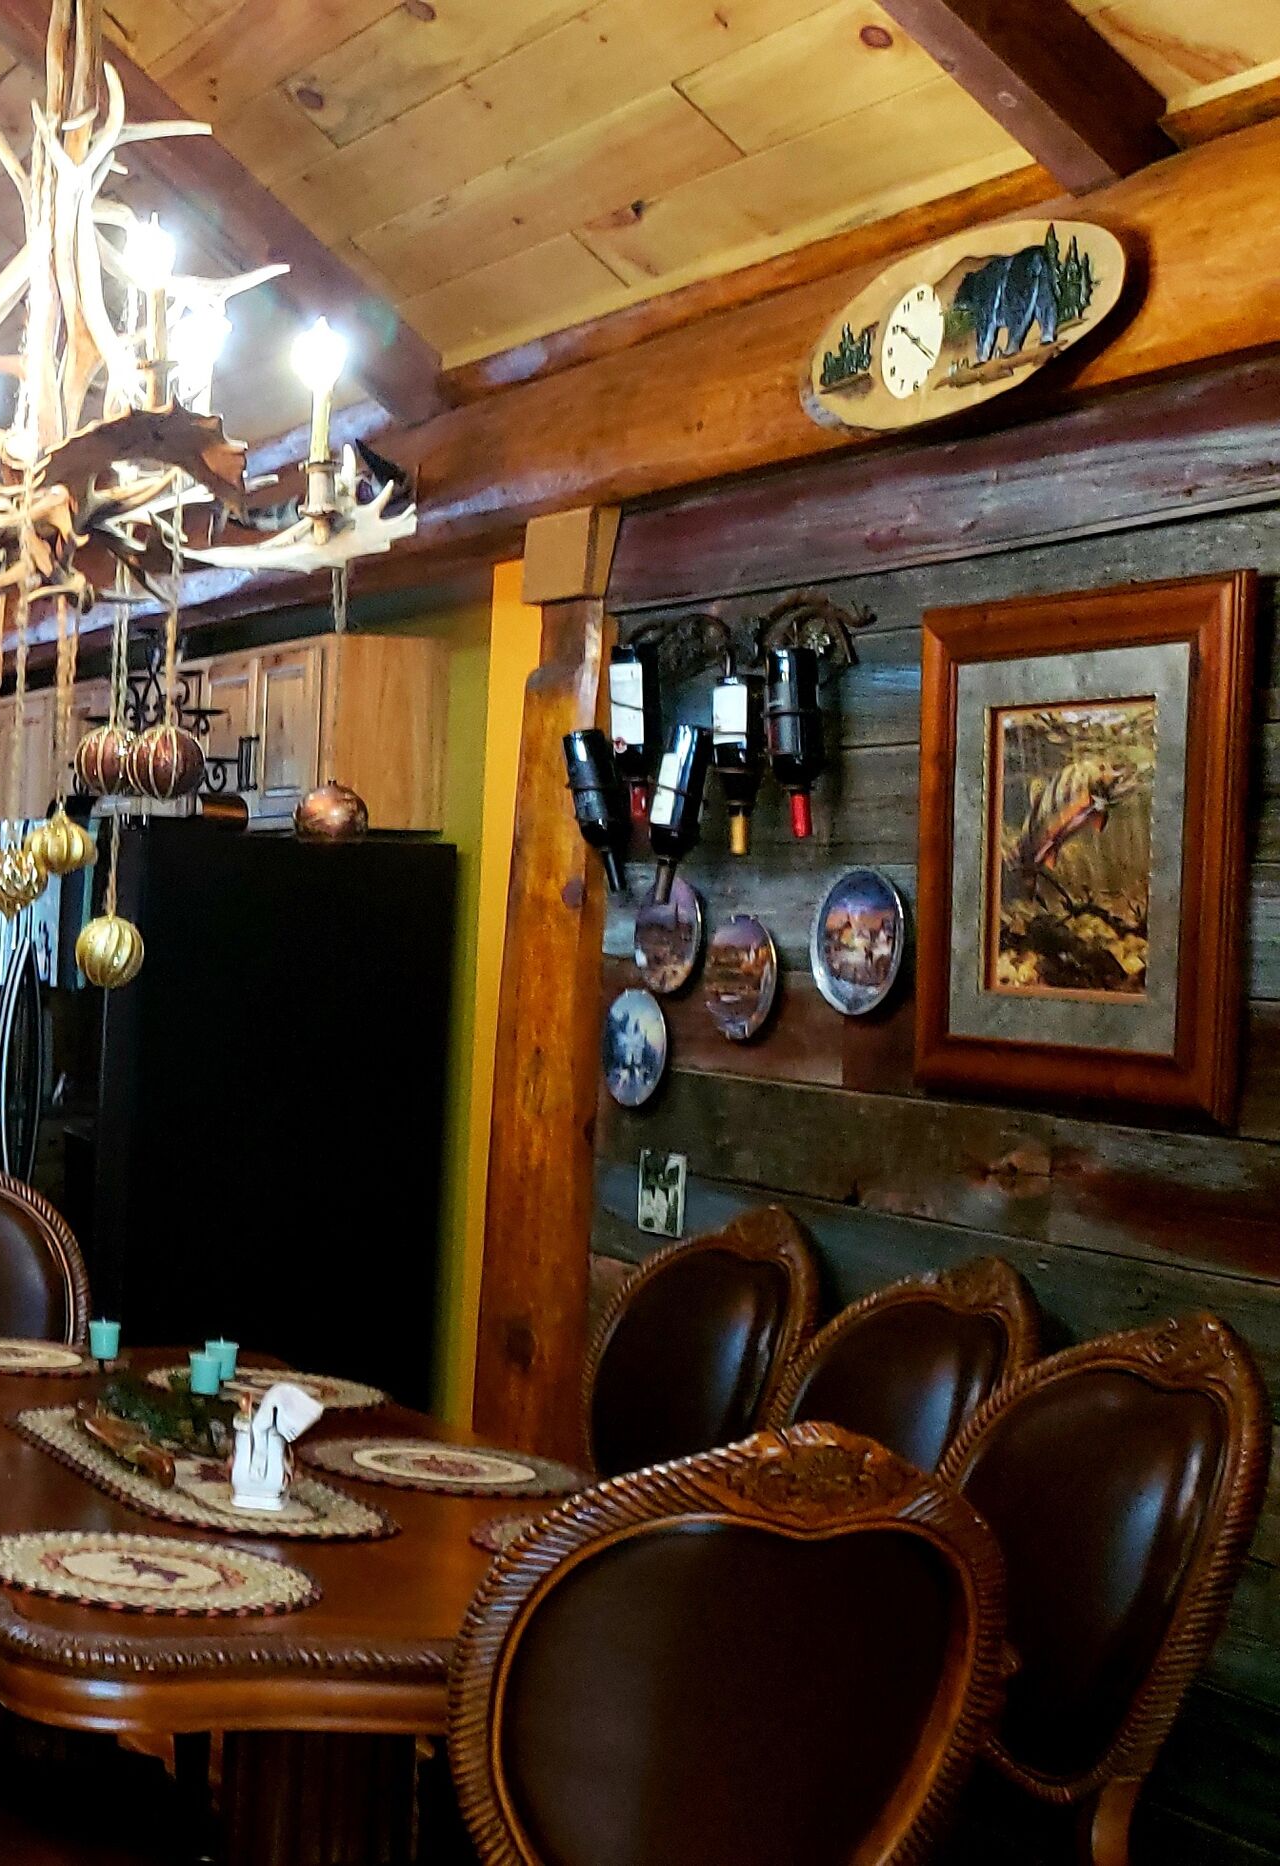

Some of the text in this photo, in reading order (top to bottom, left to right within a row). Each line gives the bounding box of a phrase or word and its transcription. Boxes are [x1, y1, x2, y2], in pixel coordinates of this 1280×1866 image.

[903, 301, 910, 314] 11
[900, 379, 905, 391] 7
[913, 380, 919, 392] 6
